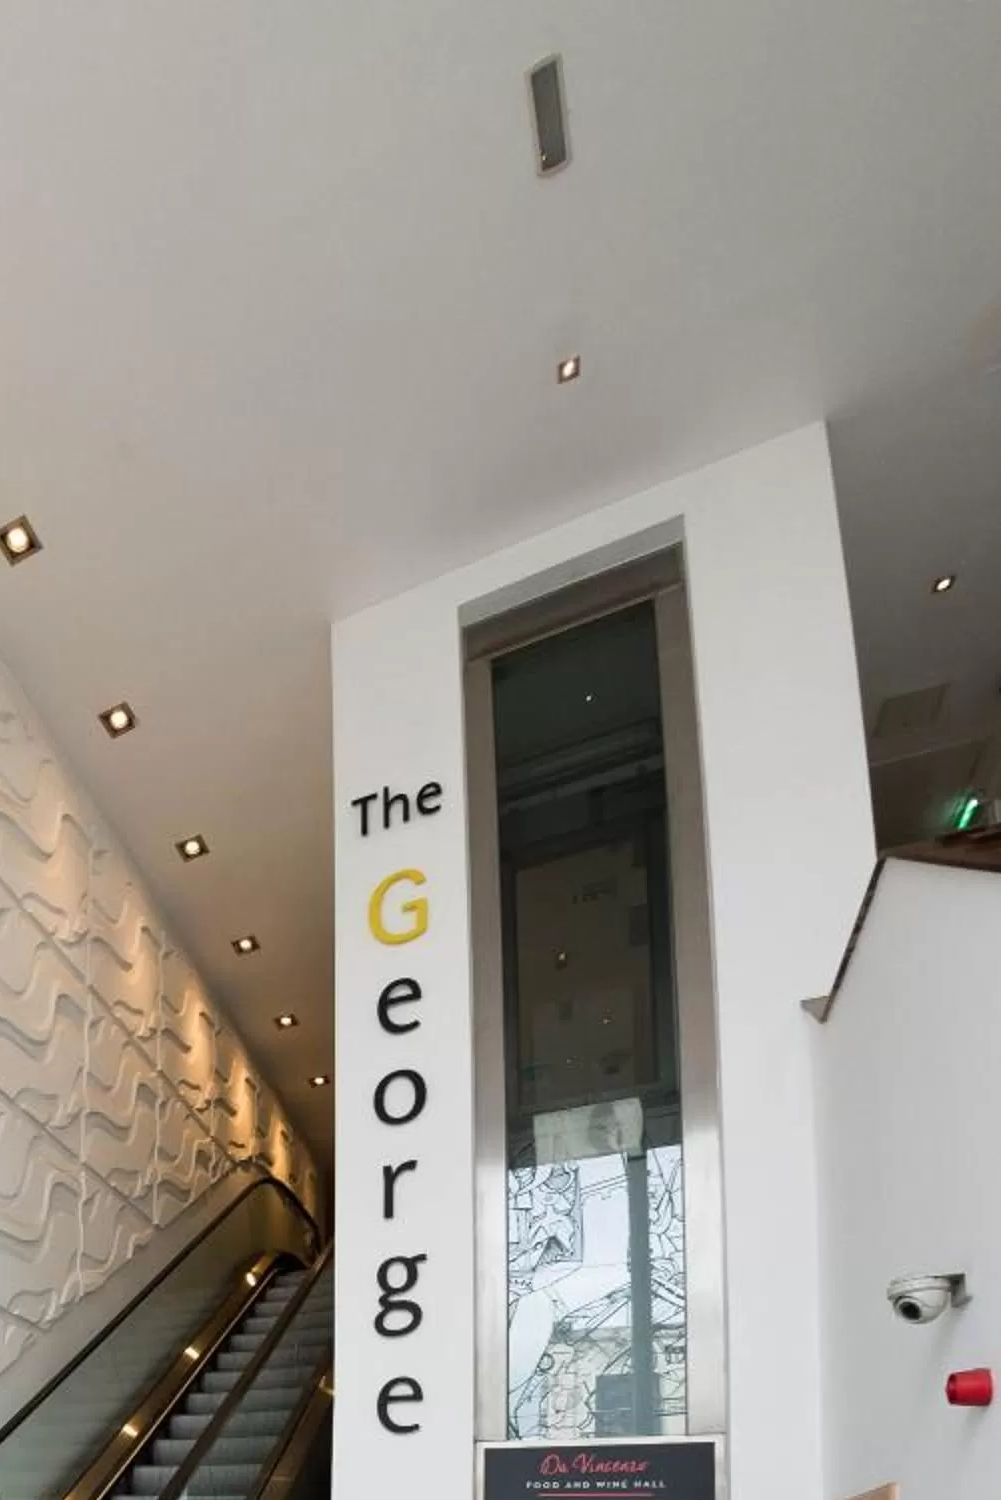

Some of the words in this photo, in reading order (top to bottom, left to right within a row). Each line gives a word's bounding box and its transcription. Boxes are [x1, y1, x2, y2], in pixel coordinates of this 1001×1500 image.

[351, 780, 443, 837] The
[367, 867, 430, 1436] George
[572, 1453, 648, 1475] Vincenzo
[526, 1481, 560, 1489] FOOD
[565, 1481, 591, 1489] AND
[596, 1480, 628, 1489] WINE
[634, 1480, 667, 1489] HALL
